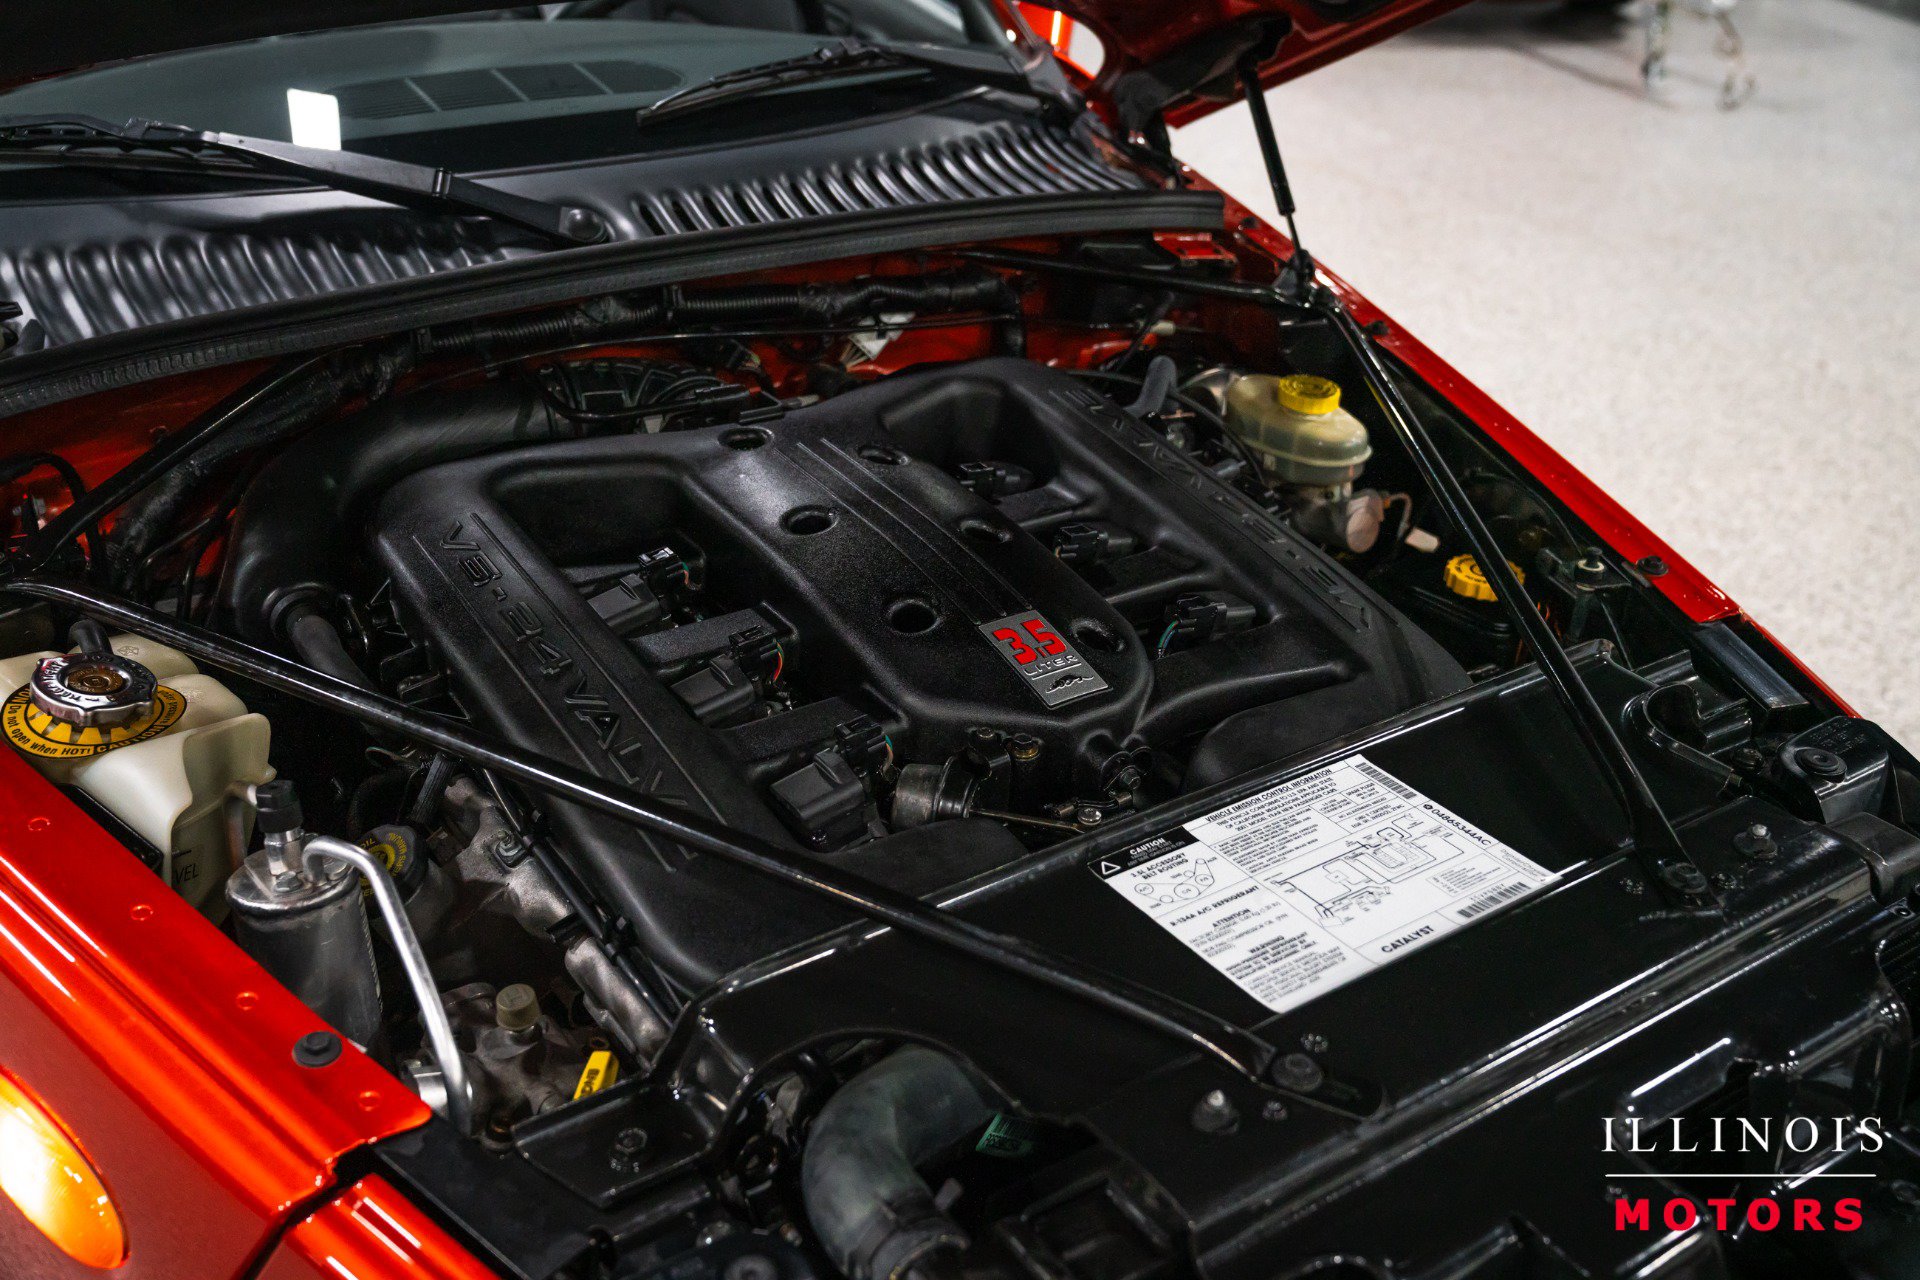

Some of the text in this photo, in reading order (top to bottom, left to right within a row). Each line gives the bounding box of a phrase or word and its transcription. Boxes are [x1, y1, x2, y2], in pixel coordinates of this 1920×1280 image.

[993, 618, 1067, 666] 3.5
[1023, 654, 1078, 677] LITER
[7, 704, 92, 756] Do not open when HOT!
[1204, 769, 1333, 822] VEHICLE EMISSION CONTROL INFORMATION
[1227, 811, 1250, 821] VEHICLE
[1128, 838, 1165, 853] CAUTION
[1141, 870, 1158, 879] BELT
[1157, 858, 1189, 872] ROUTING
[1145, 852, 1187, 870] ACCESSORY
[175, 863, 199, 882] VEL
[1169, 885, 1259, 925] R-134A A/C REFRIGERANT
[1211, 908, 1250, 926] ATTENTION
[1380, 923, 1435, 955] CATALYST
